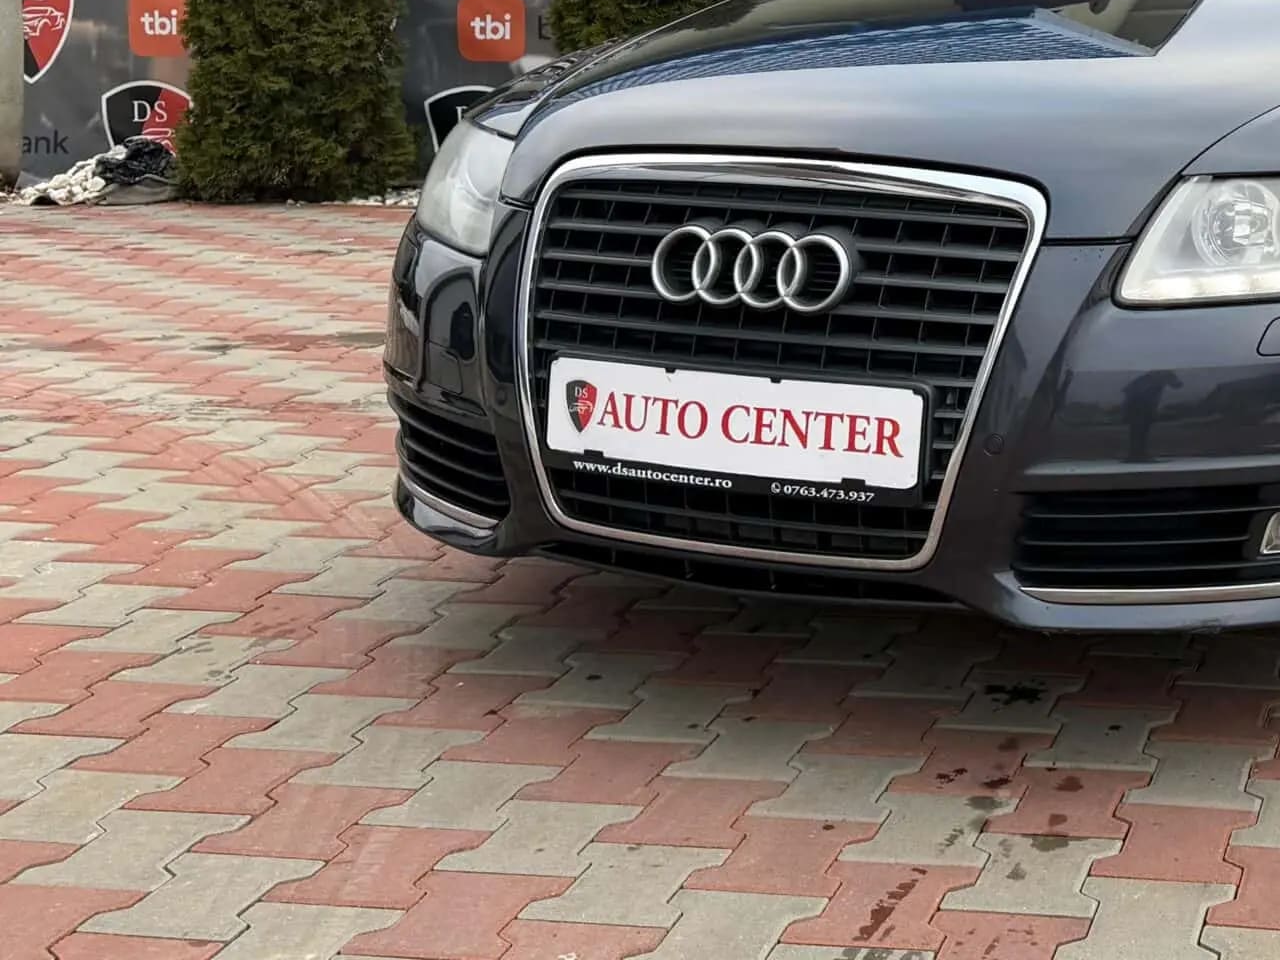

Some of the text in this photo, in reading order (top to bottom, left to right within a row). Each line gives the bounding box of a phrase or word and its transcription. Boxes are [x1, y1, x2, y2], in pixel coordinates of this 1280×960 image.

[140, 9, 178, 35] tbi
[470, 13, 511, 40] tbi
[132, 100, 168, 122] DS
[22, 130, 70, 154] ank
[597, 391, 708, 439] AUTO
[720, 404, 904, 458] CENTER
[572, 459, 875, 503] www.dsautocenter.ro 0763.473.937
